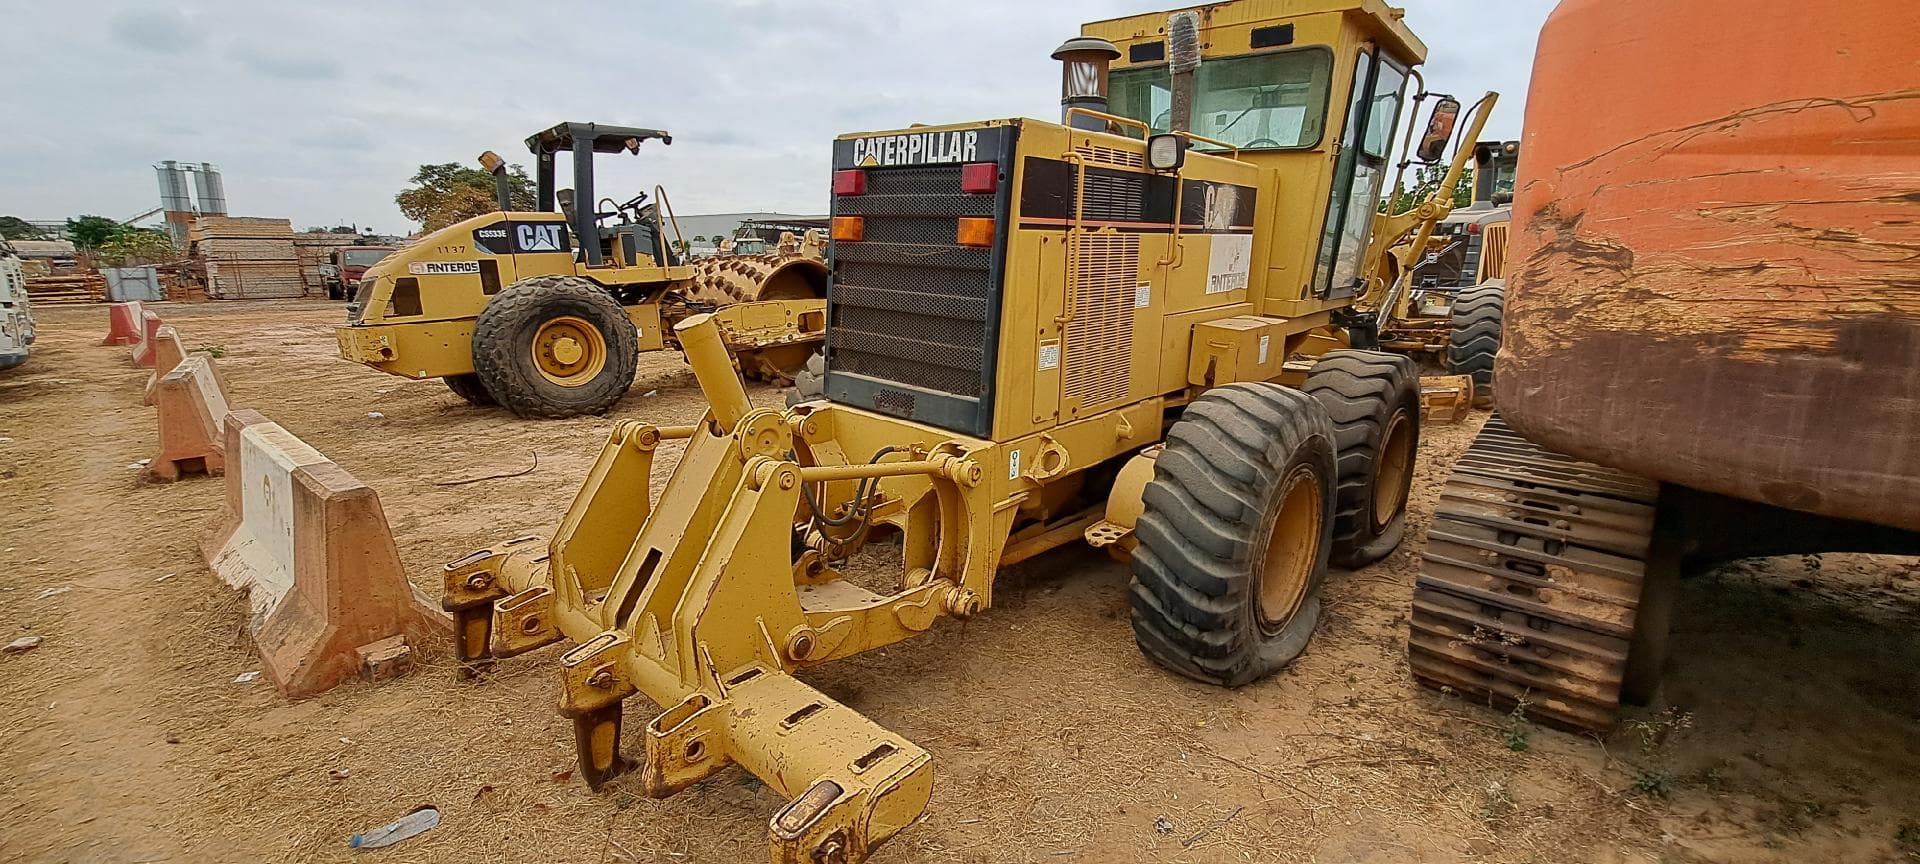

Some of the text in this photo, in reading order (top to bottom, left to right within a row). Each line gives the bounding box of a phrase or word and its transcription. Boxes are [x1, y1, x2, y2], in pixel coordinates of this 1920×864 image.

[853, 130, 978, 167] CATERPILLAR
[516, 224, 562, 251] CAT
[437, 245, 466, 254] 1137
[427, 262, 478, 273] ANTEROS
